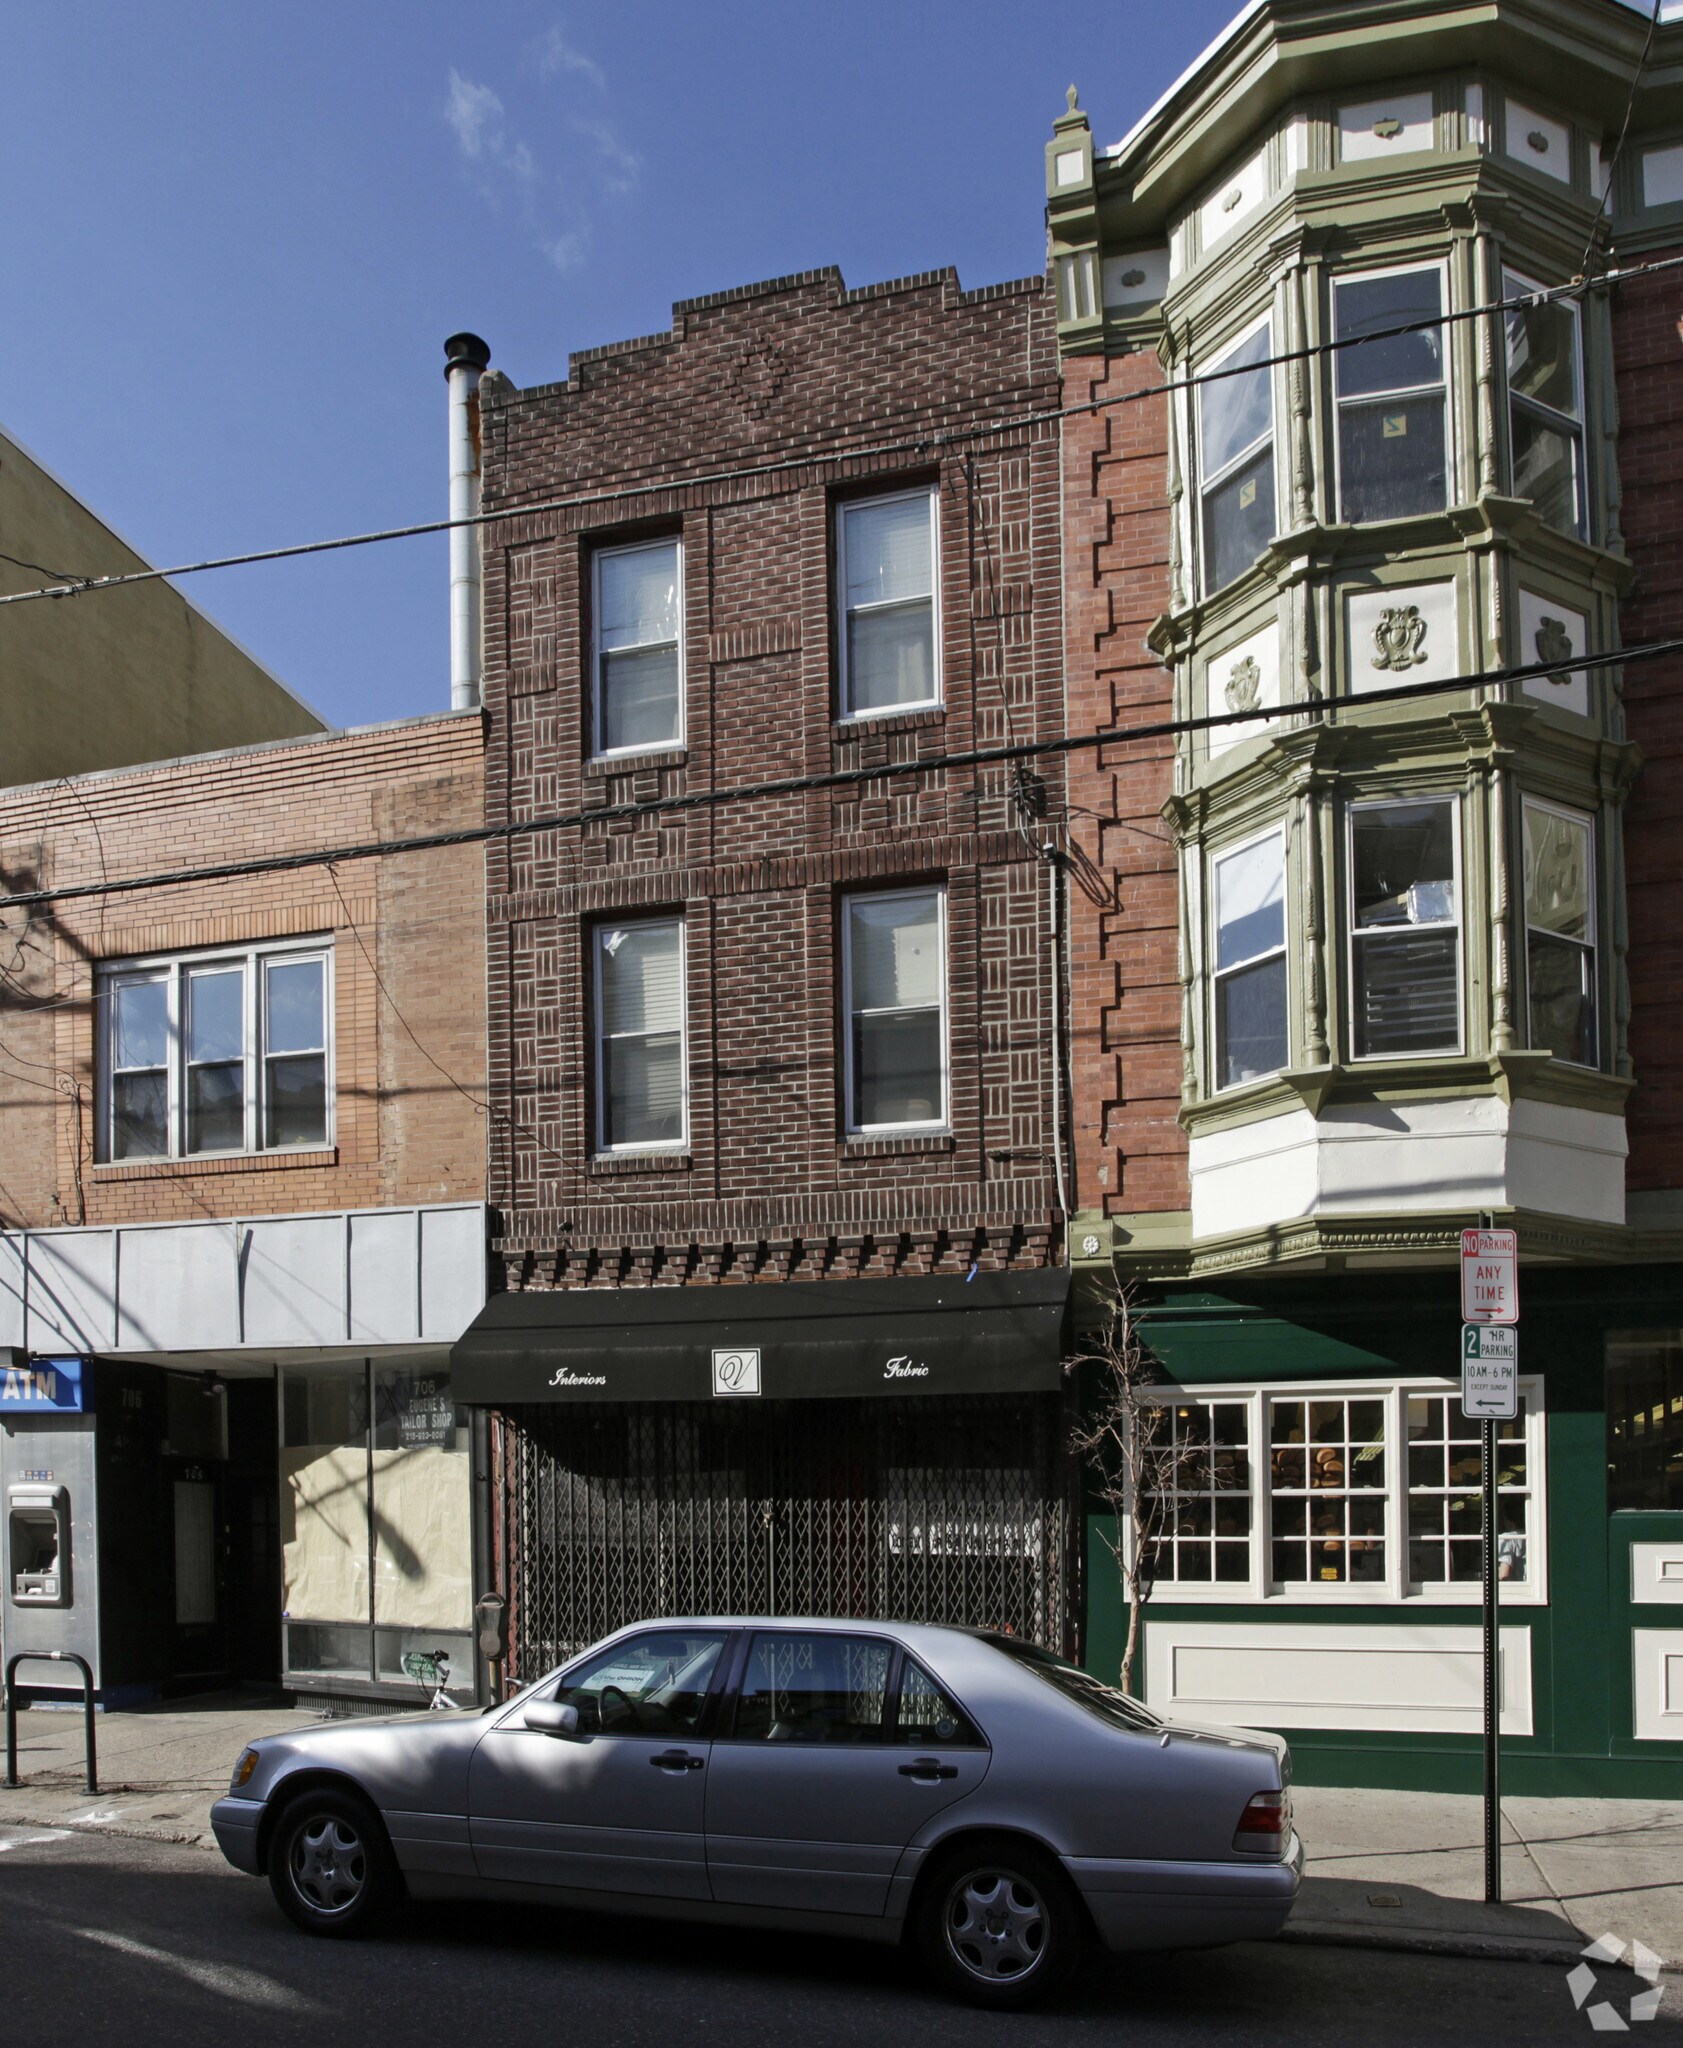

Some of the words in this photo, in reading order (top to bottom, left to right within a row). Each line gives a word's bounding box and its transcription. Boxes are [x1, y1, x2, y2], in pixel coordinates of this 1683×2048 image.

[1463, 1236, 1478, 1253] NO
[1480, 1239, 1513, 1251] PARKING
[1476, 1266, 1502, 1279] ANY
[1474, 1286, 1505, 1300] TIME
[1467, 1330, 1477, 1354] 2
[1491, 1330, 1505, 1342] HR
[1481, 1344, 1514, 1357] PARKING
[883, 1355, 929, 1378] Fabric
[548, 1367, 607, 1385] Interiors
[2, 1371, 57, 1400] ATM
[414, 1380, 436, 1395] 706
[1471, 1383, 1489, 1391] EXCEPT
[1490, 1383, 1508, 1391] SUNDAY
[121, 1388, 143, 1409] 706
[409, 1396, 446, 1412] EUGENE'S
[401, 1414, 427, 1429] TAILOR
[431, 1412, 452, 1428] SHOP
